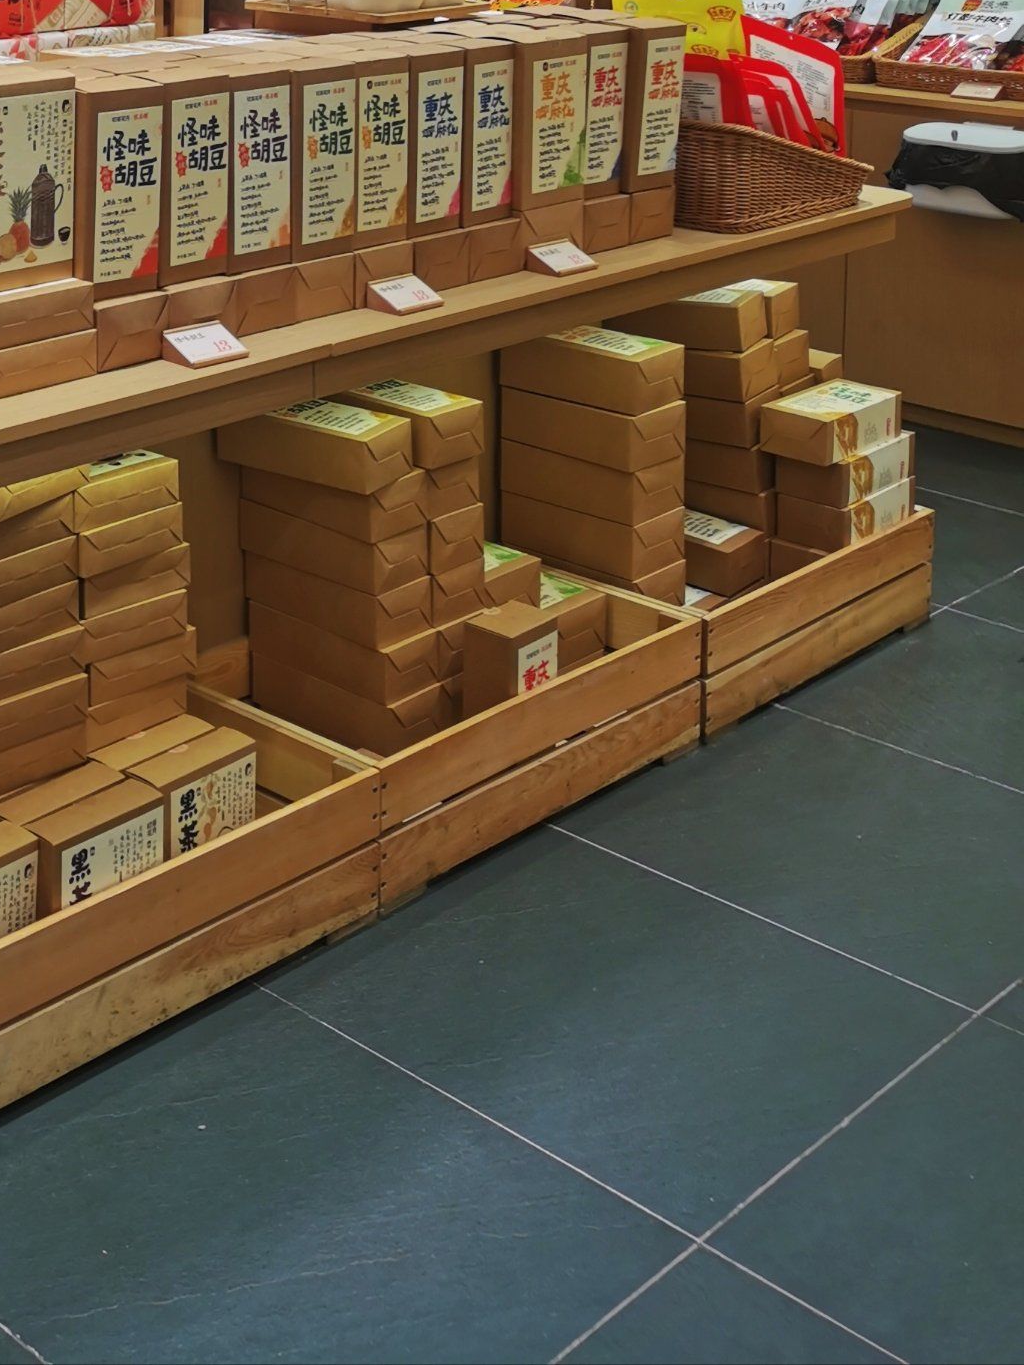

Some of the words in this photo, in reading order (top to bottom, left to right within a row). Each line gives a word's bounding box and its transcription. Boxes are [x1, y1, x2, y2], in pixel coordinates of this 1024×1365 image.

[540, 71, 571, 101] 重庆
[593, 66, 619, 92] 重庆
[650, 59, 677, 85] 重庆
[364, 94, 401, 123] 怪味
[423, 92, 453, 122] 重庆
[478, 84, 505, 113] 重庆
[178, 115, 221, 147] 怪味
[240, 108, 281, 139] 怪味
[309, 102, 348, 132] 怪味
[103, 129, 151, 162] 怪味
[319, 127, 353, 155] 胡豆
[373, 119, 406, 146] 胡豆
[189, 142, 228, 171] 胡豆
[251, 135, 288, 163] 胡豆
[115, 157, 157, 188] 胡豆
[213, 340, 234, 353] 13
[522, 660, 552, 692] 重庆
